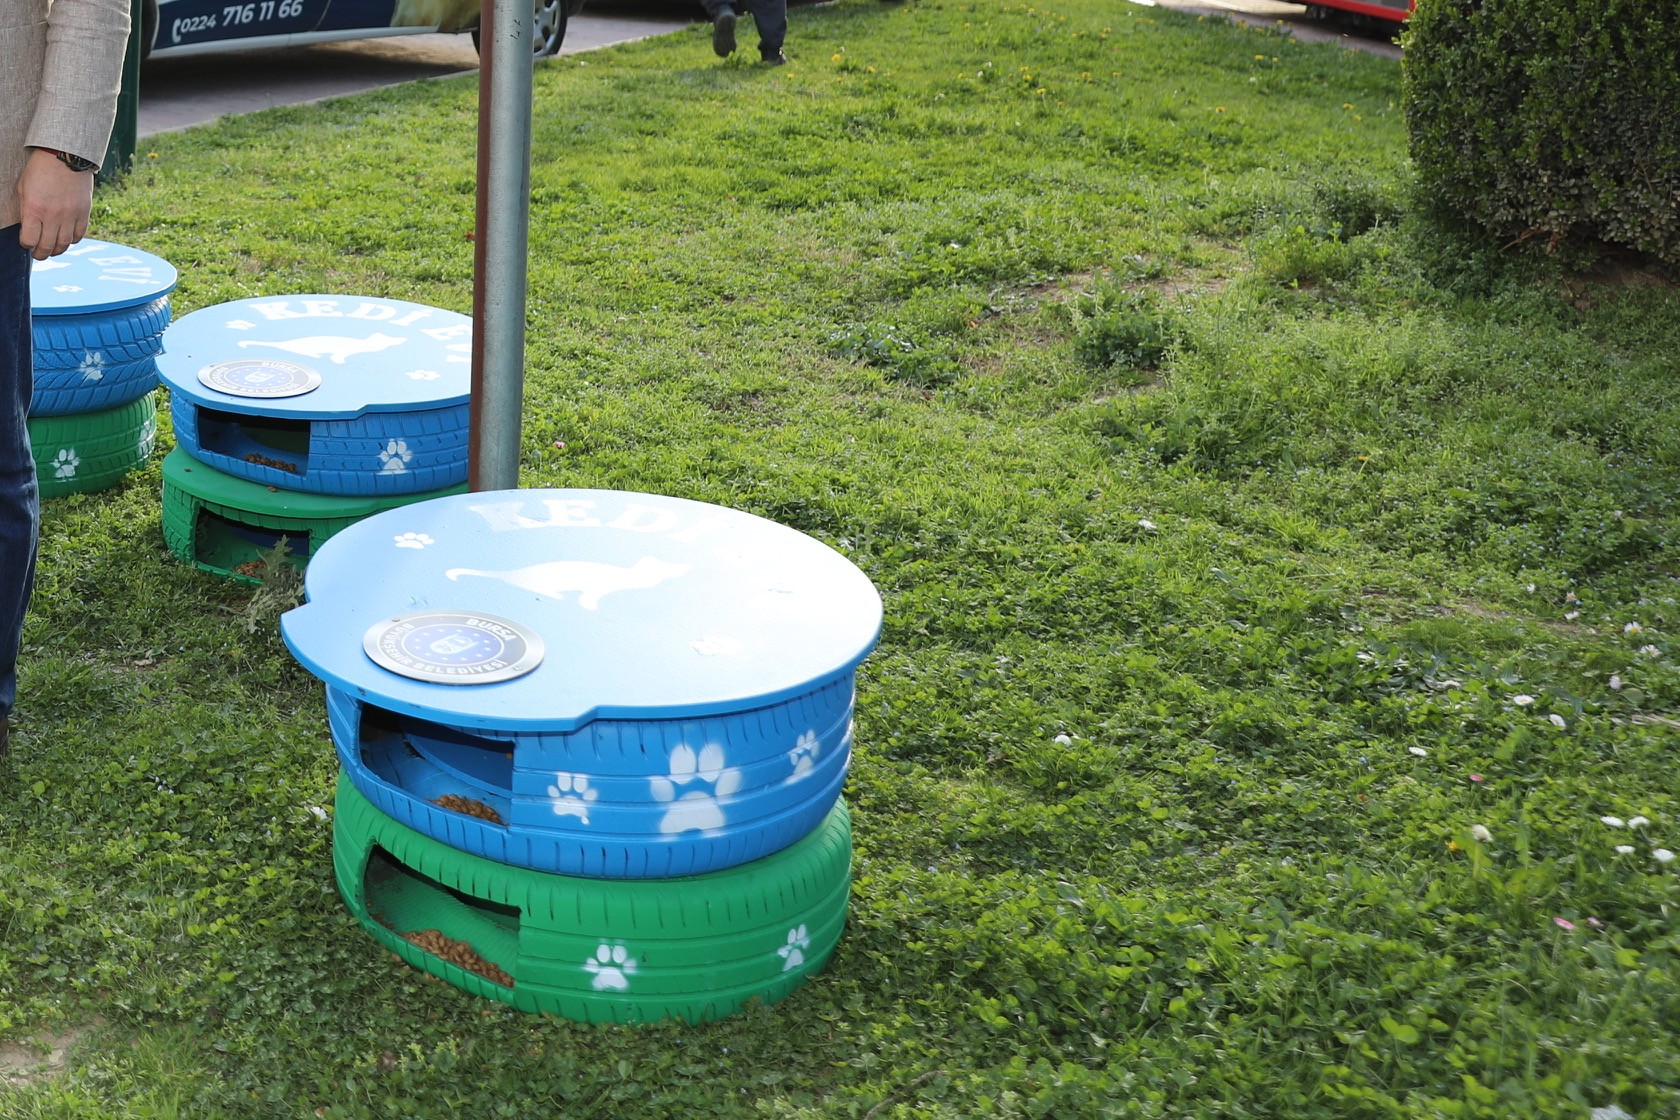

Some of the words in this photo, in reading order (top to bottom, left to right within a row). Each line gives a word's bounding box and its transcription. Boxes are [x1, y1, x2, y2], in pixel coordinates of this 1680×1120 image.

[181, 14, 216, 33] 0224
[222, 3, 256, 27] 716
[259, 1, 276, 21] 11
[465, 618, 517, 642] BURSA
[412, 658, 509, 675] BELEDİYESİ
